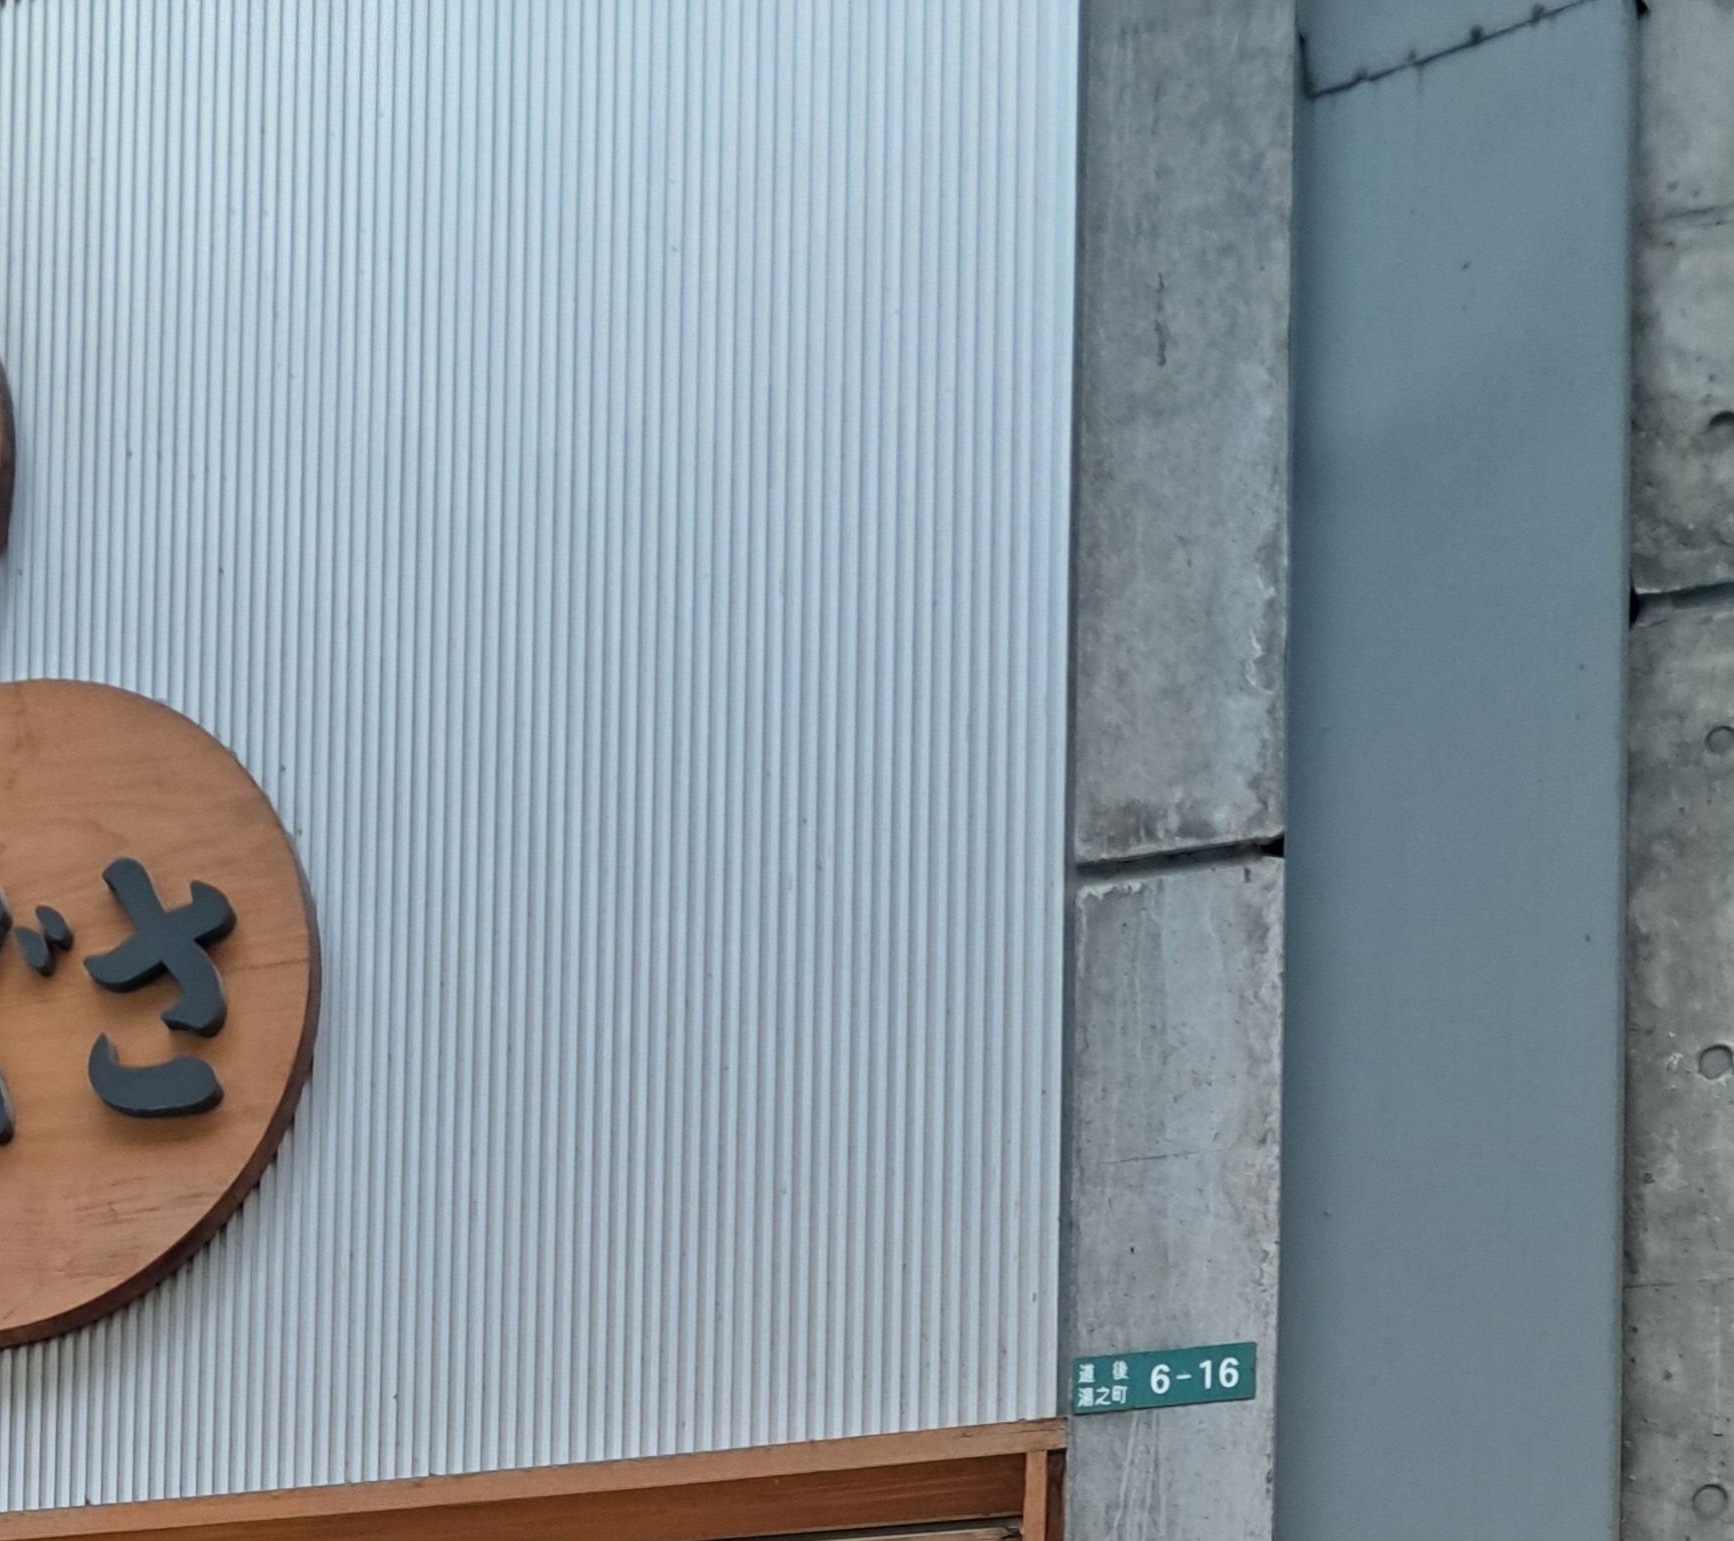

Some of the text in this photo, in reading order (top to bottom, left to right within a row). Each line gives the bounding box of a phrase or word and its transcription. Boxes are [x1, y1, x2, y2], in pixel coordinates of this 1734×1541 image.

[1078, 1360, 1129, 1383] 道後
[1150, 1357, 1240, 1395] 6-16
[1078, 1385, 1129, 1407] 湯之町
